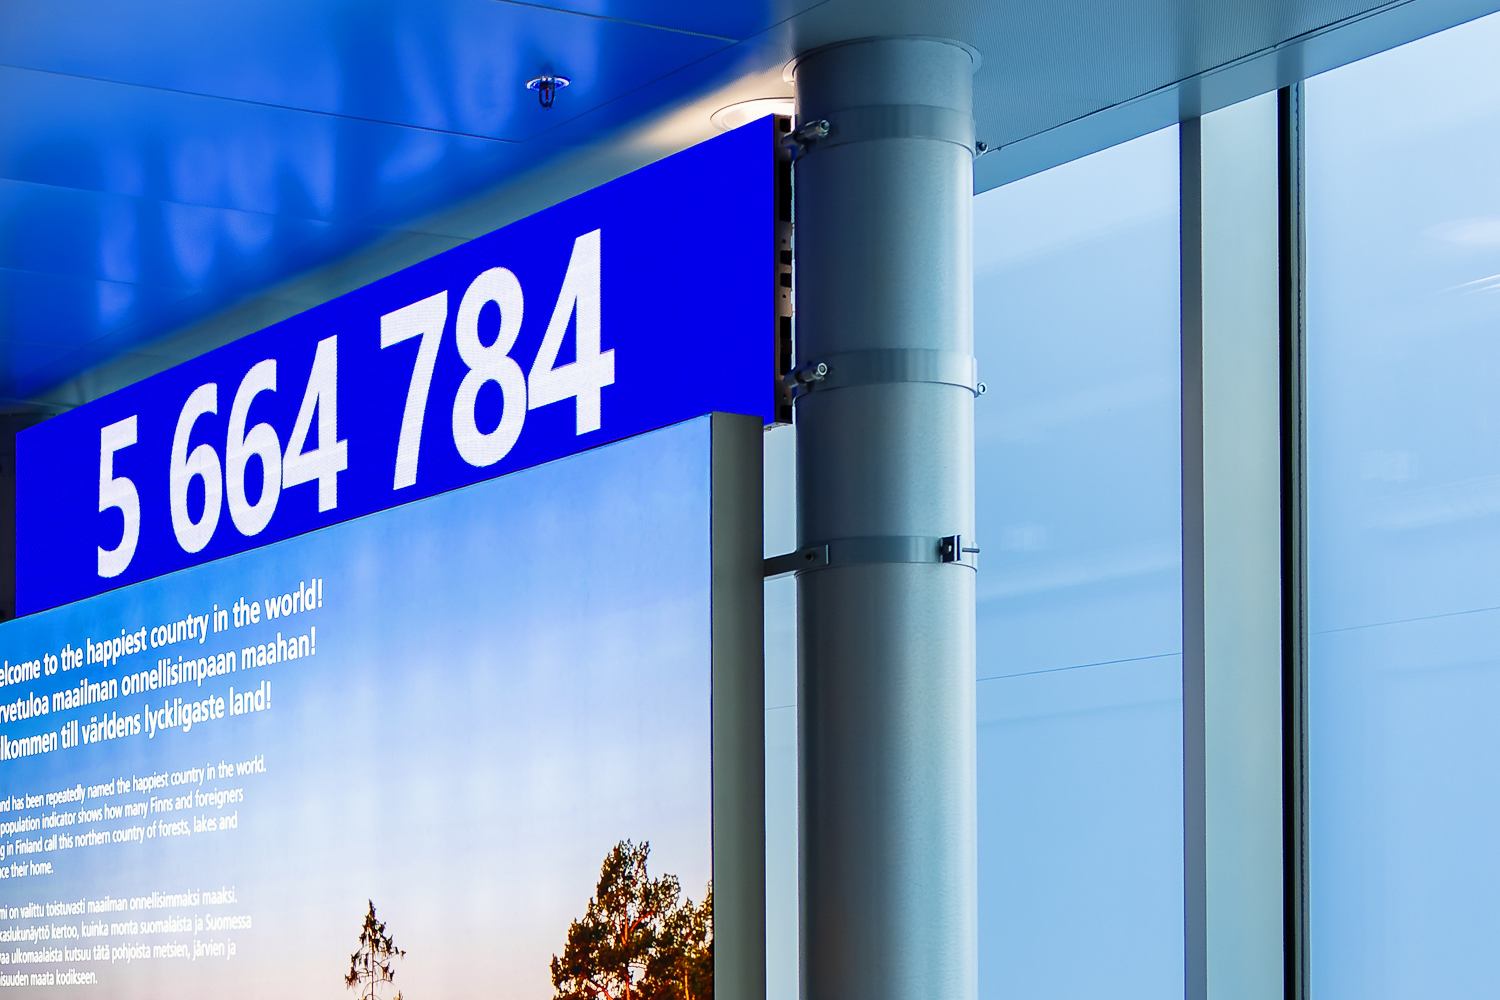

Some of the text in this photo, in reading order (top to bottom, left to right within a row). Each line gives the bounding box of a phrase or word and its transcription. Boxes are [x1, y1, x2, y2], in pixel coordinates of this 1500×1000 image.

[97, 228, 615, 578] 5 664 784
[42, 652, 58, 676] to
[60, 643, 84, 672] the
[86, 625, 148, 668] happiest
[149, 613, 210, 649] country
[213, 603, 229, 633] in
[231, 596, 261, 628] the
[264, 577, 323, 620] world!
[51, 677, 118, 713] maailman
[120, 650, 236, 696] onnellisimpaan
[241, 625, 316, 670] maahan!
[59, 718, 78, 749] till
[80, 710, 141, 745] världens
[144, 694, 225, 739] lyckligaste
[229, 679, 271, 716] land!
[11, 794, 25, 811] has
[24, 792, 45, 809] been
[45, 783, 86, 808] repeatedly
[86, 777, 115, 799] named
[115, 776, 131, 794] the
[132, 771, 169, 794] happiest
[170, 766, 205, 787] country
[206, 762, 216, 780] in
[217, 759, 235, 779] the
[235, 753, 267, 776] world.
[0, 814, 41, 839] population
[41, 810, 77, 829] indicator
[76, 806, 103, 824] shows
[103, 802, 124, 820] how
[124, 801, 149, 819] many
[149, 795, 174, 814] Finns
[174, 789, 193, 810] and
[194, 786, 244, 809] foreigners
[6, 840, 14, 856] in
[14, 835, 43, 855] Finland
[43, 833, 58, 852] call
[57, 831, 74, 850] this
[74, 828, 111, 848] northern
[111, 824, 146, 844] country
[145, 819, 157, 839] of
[157, 818, 191, 837] forests,
[193, 813, 218, 833] lakes
[218, 809, 238, 830] and
[9, 860, 29, 878] their
[29, 859, 54, 876] home.
[8, 906, 19, 920] on
[19, 901, 45, 919] valittu
[45, 897, 86, 917] toistuvasti
[87, 894, 128, 913] maailman
[129, 887, 200, 911] onnellisimmaksi
[202, 884, 238, 905] maaksi.
[50, 922, 80, 940] kertoo,
[80, 919, 109, 937] kuinka
[110, 919, 139, 936] monta
[139, 914, 193, 935] suomalaista
[194, 913, 204, 936] ja
[204, 912, 252, 931] Suomessa
[10, 945, 63, 964] ulkomaalaista
[64, 945, 91, 962] kutsuu
[92, 944, 110, 961] tätä
[111, 941, 151, 964] pohjoista
[152, 939, 191, 960] metsien,
[192, 938, 225, 961] järvien
[226, 937, 236, 961] ja
[30, 970, 55, 986] maata
[55, 967, 98, 985] kodikseen.
